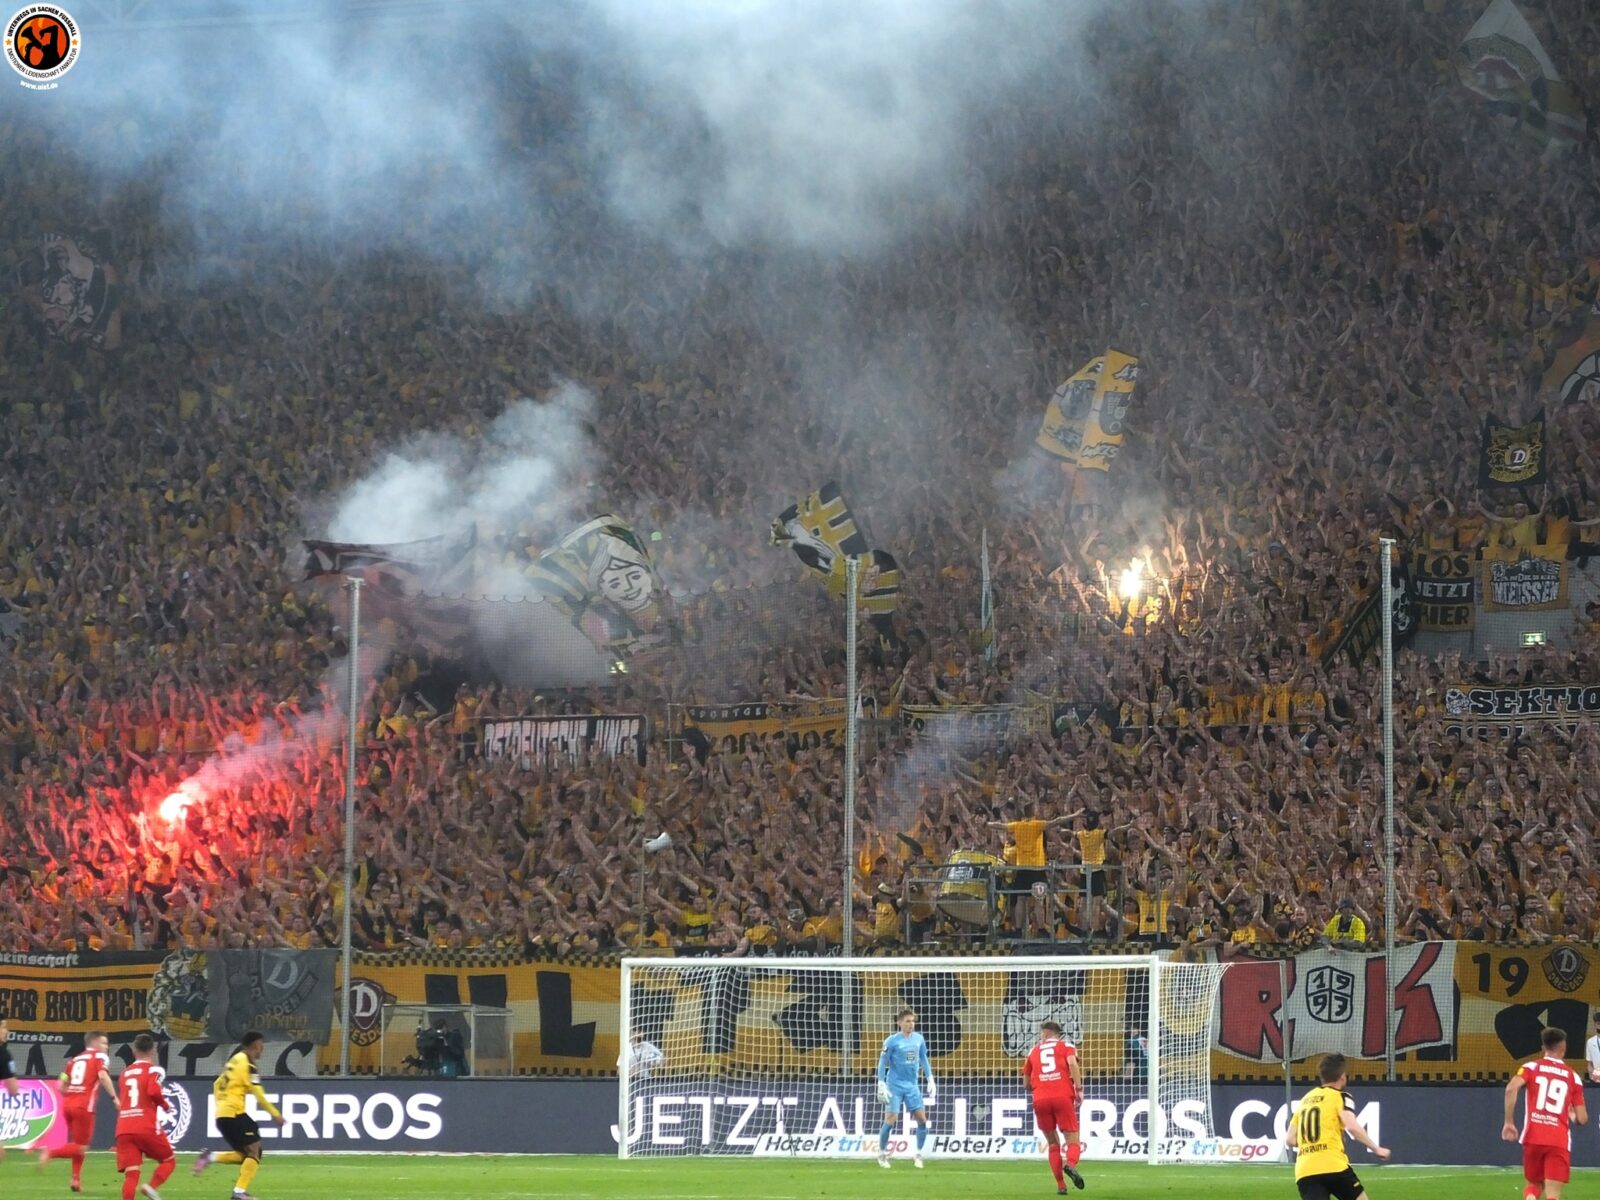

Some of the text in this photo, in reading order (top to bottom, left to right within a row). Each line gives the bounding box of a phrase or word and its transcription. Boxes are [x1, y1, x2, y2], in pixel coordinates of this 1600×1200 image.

[1417, 554, 1470, 578] LOS
[1415, 581, 1471, 598] JETZT
[1491, 580, 1560, 605] MEISSEN
[1472, 952, 1529, 997] 19
[45, 988, 147, 1022] BAUTZEN
[6, 1031, 64, 1042] Dresden
[1040, 1048, 1056, 1073] 5
[1535, 1076, 1568, 1115] 19
[610, 1096, 799, 1146] JETZT
[1300, 1106, 1321, 1143] 10
[766, 1135, 835, 1153] Hotel?
[932, 1137, 1007, 1154] Hotel?
[1192, 1140, 1269, 1161] trivago
